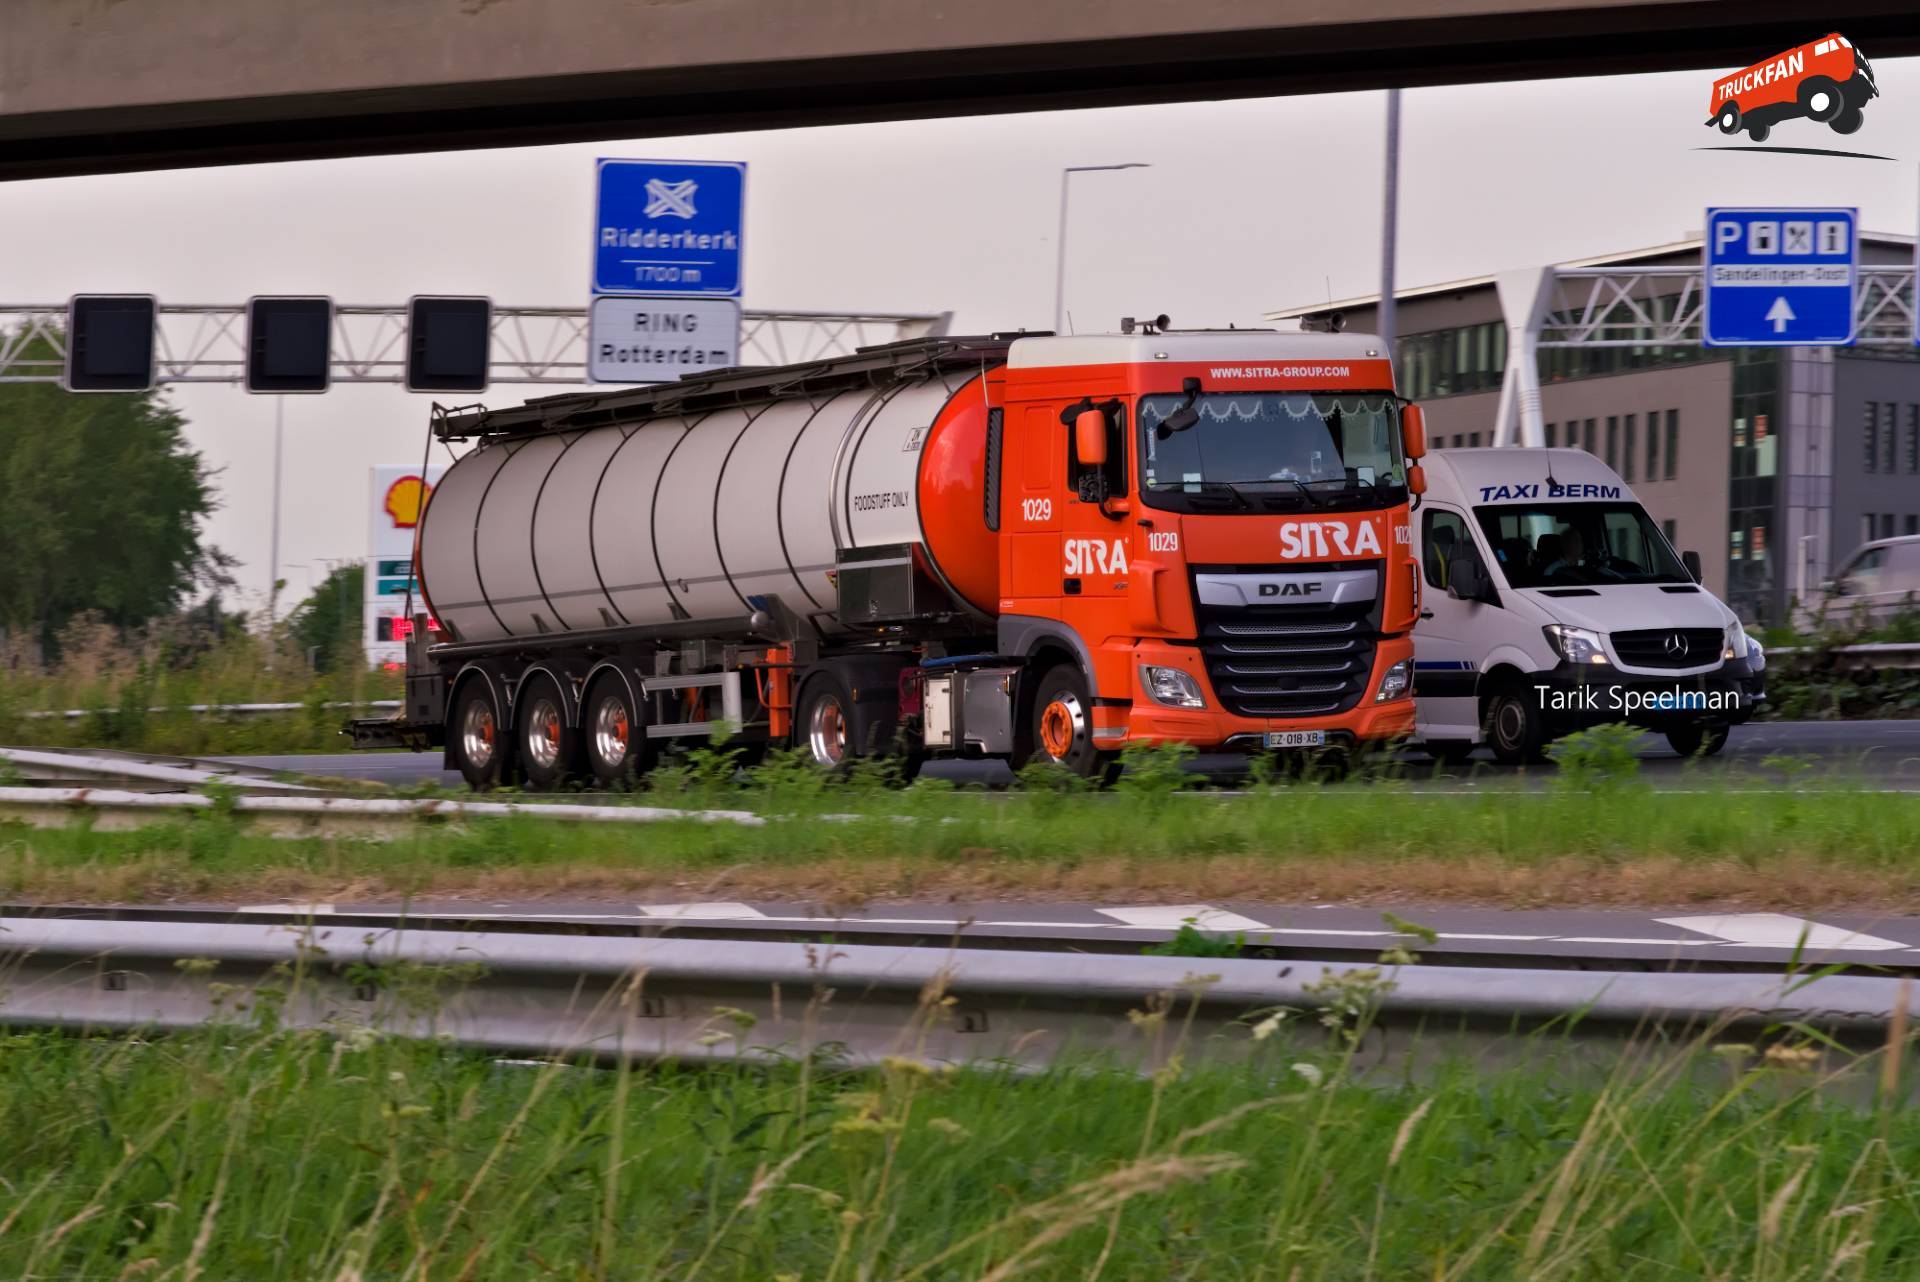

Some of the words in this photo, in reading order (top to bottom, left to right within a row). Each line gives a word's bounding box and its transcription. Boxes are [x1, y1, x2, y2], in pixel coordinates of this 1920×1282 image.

[600, 227, 738, 250] Ridderkerk
[634, 266, 680, 282] 1700
[682, 268, 701, 283] m
[1715, 267, 1847, 284] Sandelingen-Oost
[633, 313, 698, 333] RING
[600, 344, 729, 365] Rotterdam
[1210, 366, 1350, 379] WWW.SITRA-GROUP.COM
[854, 493, 891, 512] FOODSTUFF
[892, 491, 909, 508] ONLY
[1480, 484, 1538, 502] TAXI
[1547, 484, 1620, 499] BERM
[1022, 499, 1052, 521] 1029
[1148, 532, 1178, 552] 1029
[1280, 520, 1383, 559] SITRA
[1394, 525, 1411, 545] 102
[1064, 539, 1128, 575] SITRA
[1258, 581, 1322, 597] DAF
